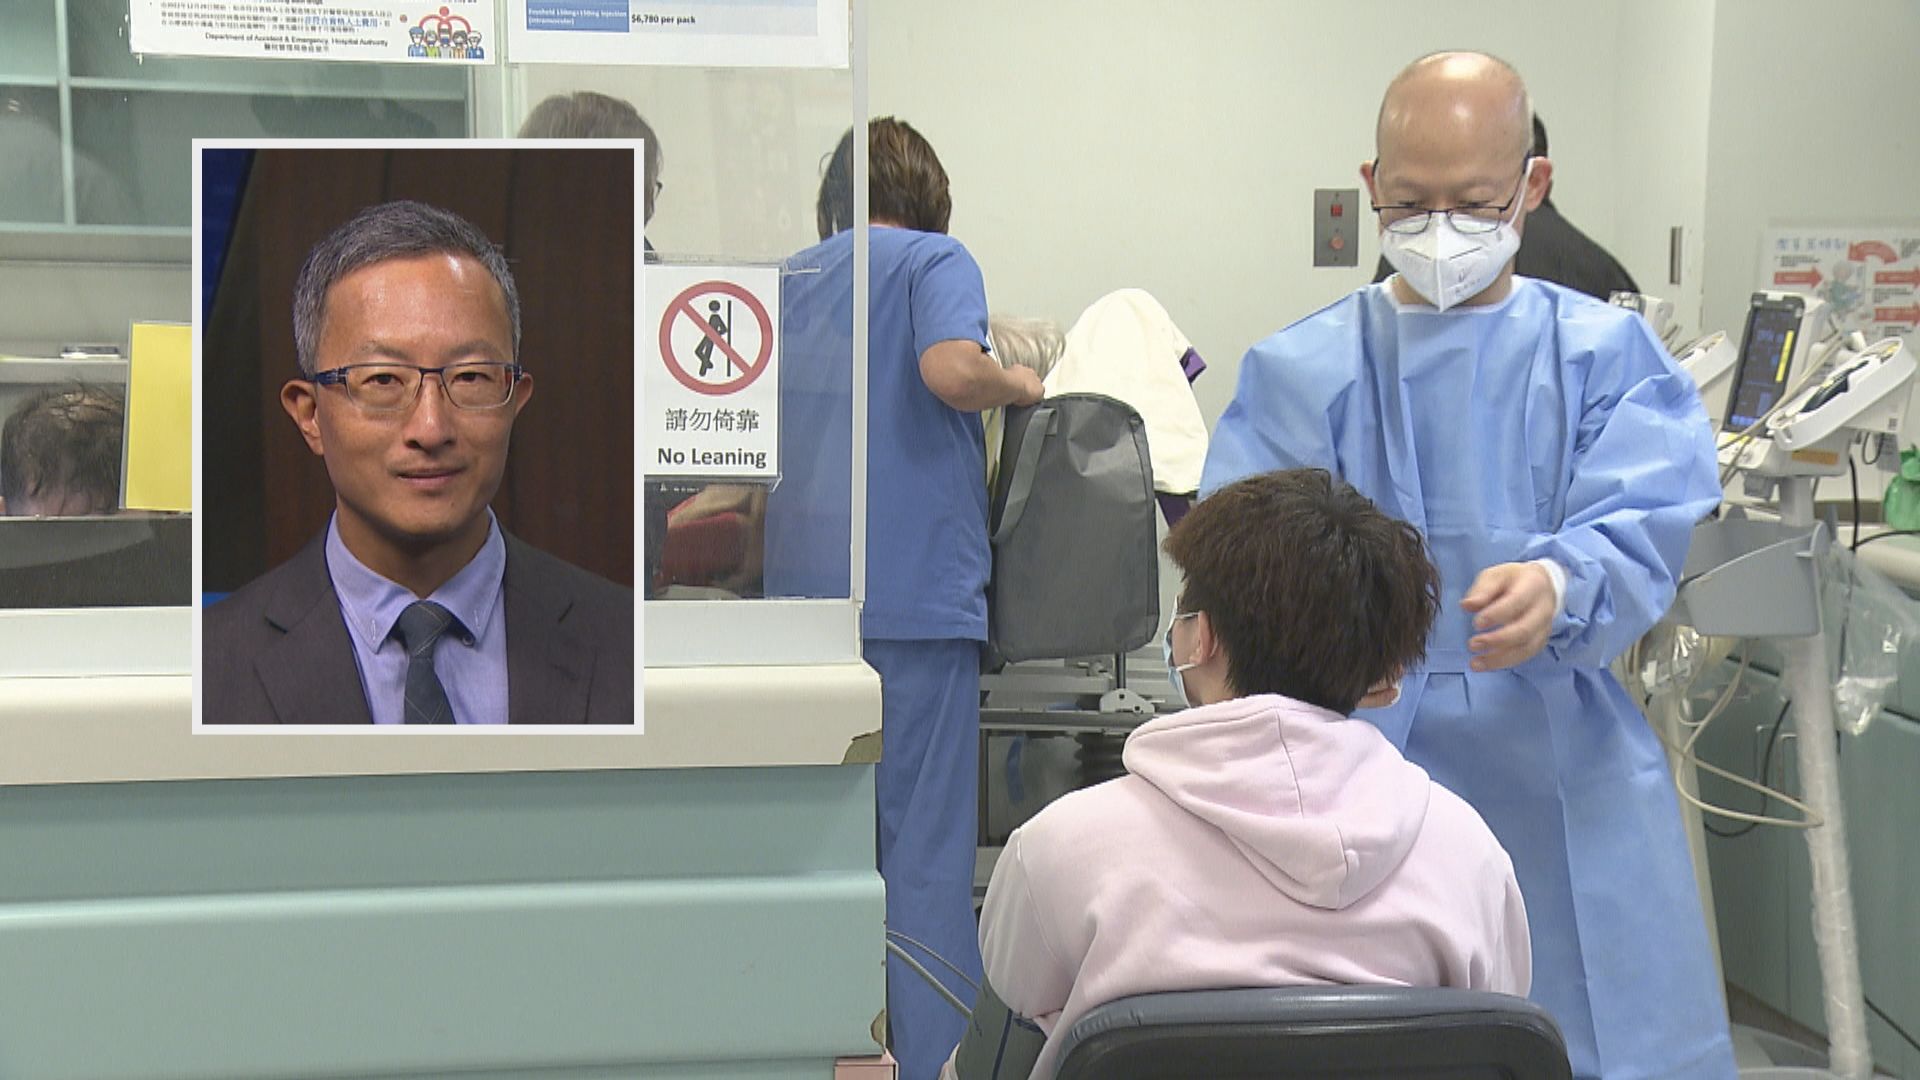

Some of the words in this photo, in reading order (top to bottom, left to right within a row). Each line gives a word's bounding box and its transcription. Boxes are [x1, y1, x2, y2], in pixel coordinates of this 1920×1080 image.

[631, 14, 659, 24] $6,780
[661, 16, 674, 25] per
[677, 15, 696, 25] pack
[205, 32, 244, 41] Department
[331, 37, 359, 45] Hospital
[359, 38, 388, 47] Authority
[665, 407, 760, 433] 請勿倚靠
[657, 447, 685, 465] No
[692, 447, 767, 469] Leaning
